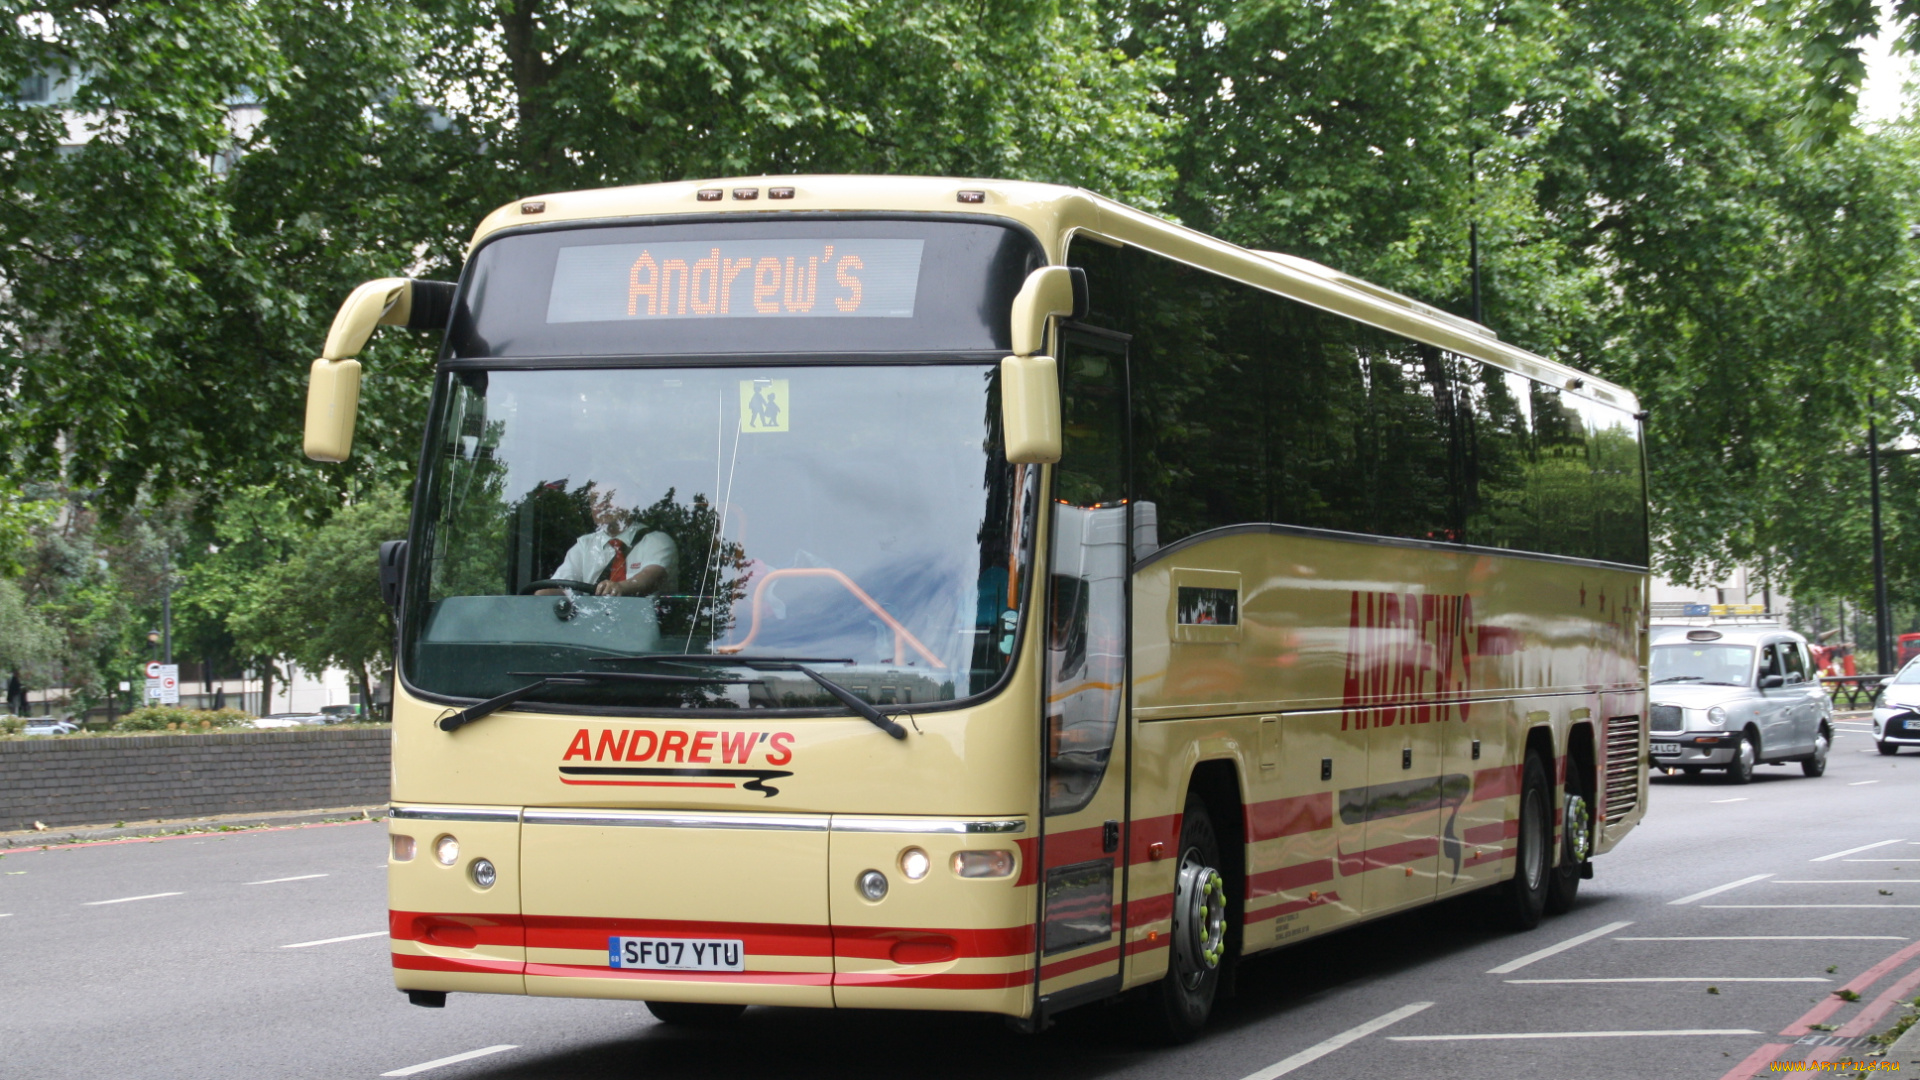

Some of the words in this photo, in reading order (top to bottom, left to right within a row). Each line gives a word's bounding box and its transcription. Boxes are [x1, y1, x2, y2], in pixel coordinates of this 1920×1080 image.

[627, 245, 864, 316] Andrew's
[1341, 590, 1474, 731] ANDREW'S
[562, 729, 796, 766] ANDREW'S
[610, 955, 620, 963] GB
[625, 940, 685, 965] SF07
[692, 942, 739, 966] YTU
